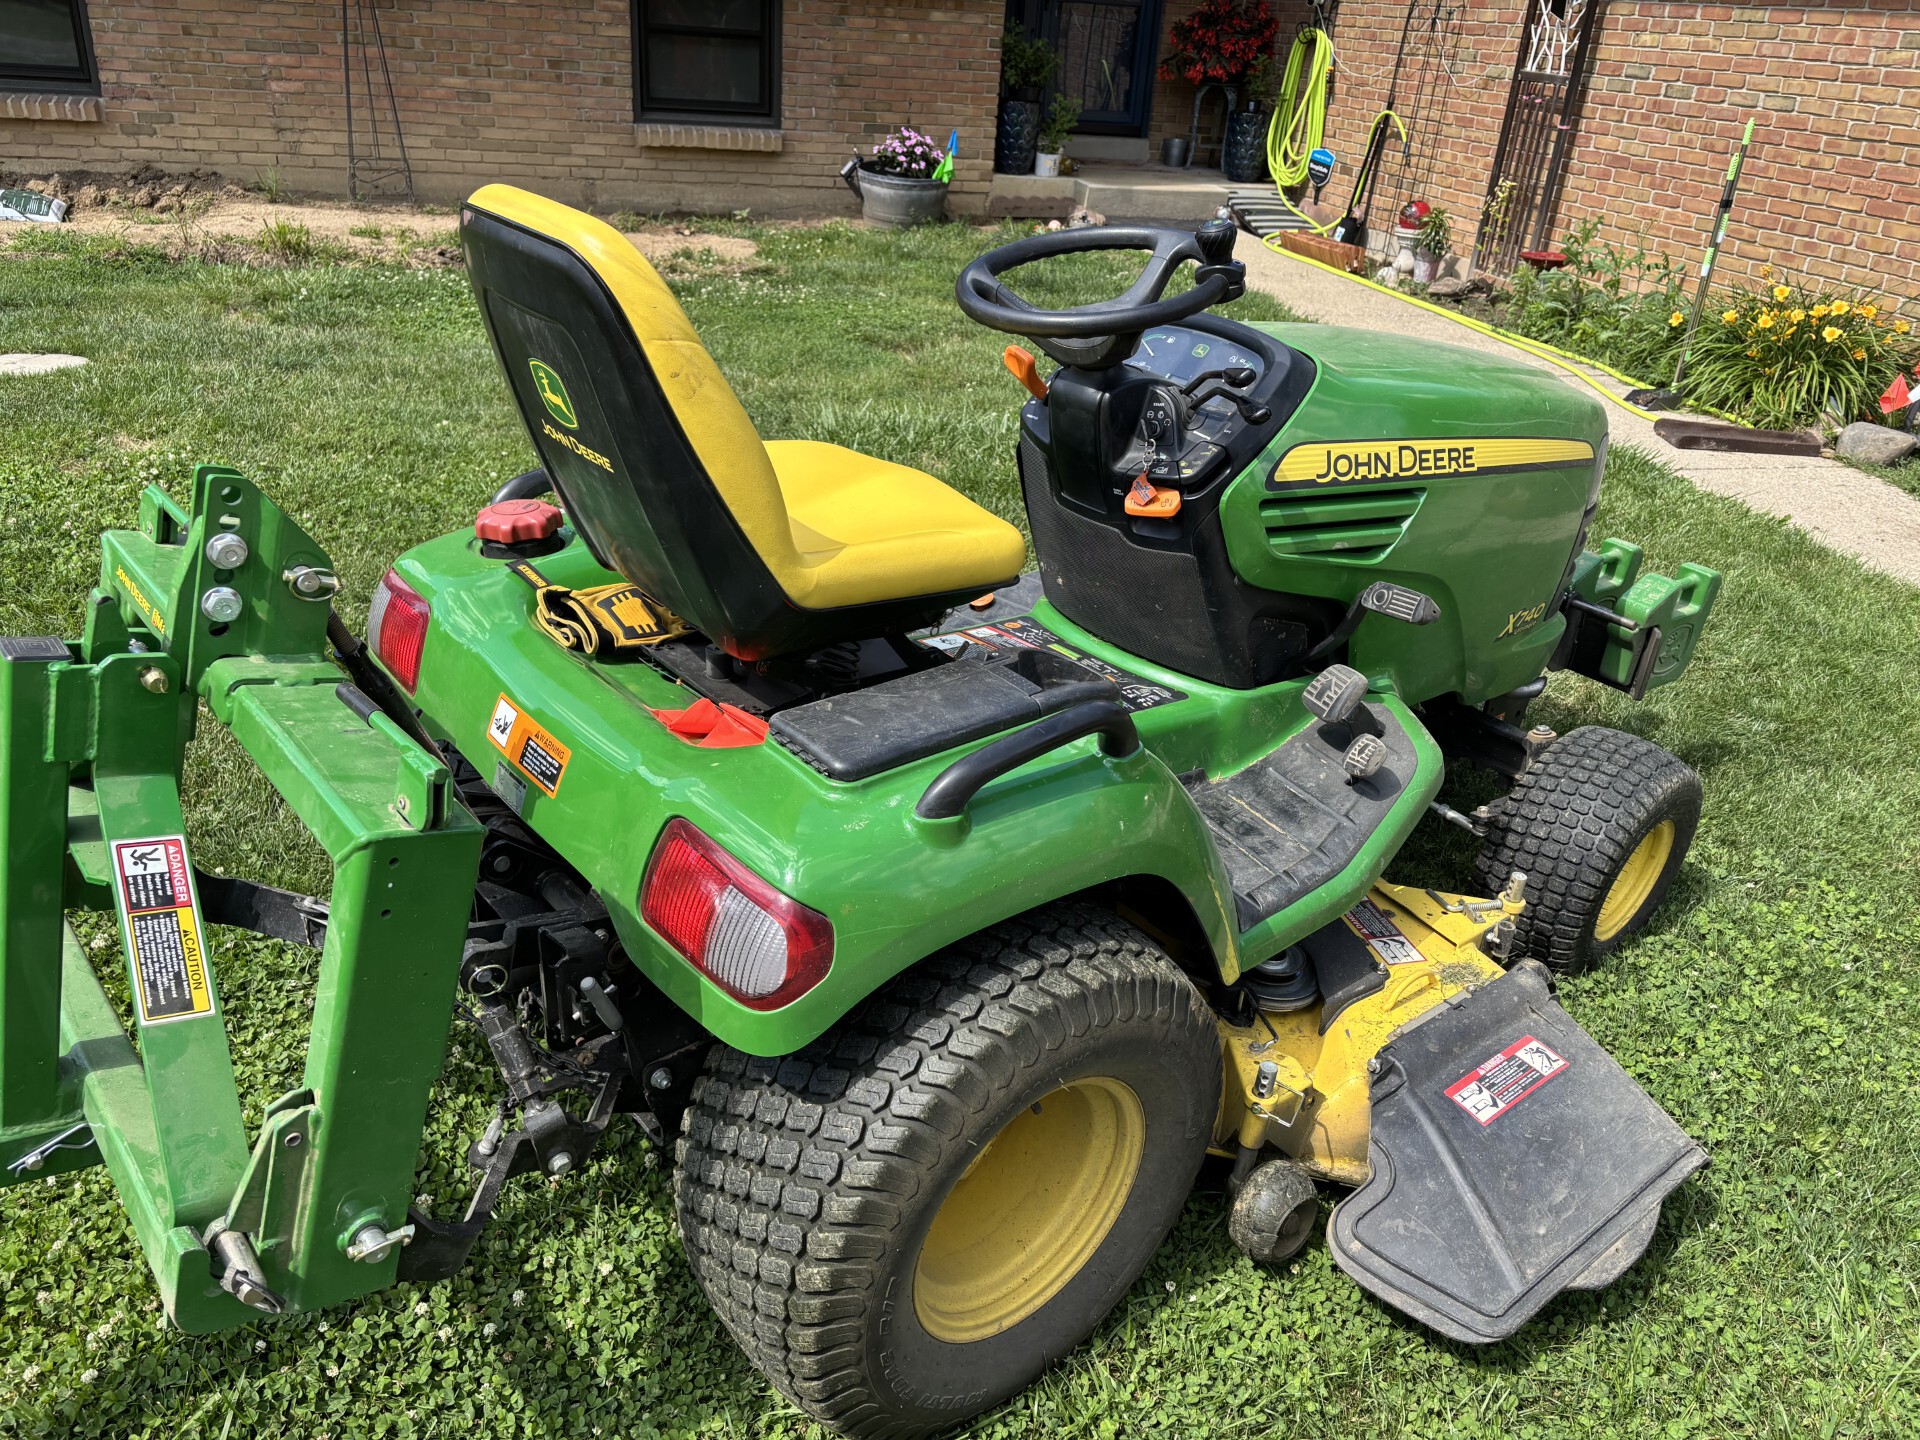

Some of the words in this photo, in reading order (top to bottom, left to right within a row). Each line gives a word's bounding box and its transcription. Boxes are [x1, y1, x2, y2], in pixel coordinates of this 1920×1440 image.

[541, 418, 572, 450] JOHN
[568, 435, 615, 474] DEERE
[1316, 449, 1391, 481] JOHN
[1398, 445, 1476, 473] DEERE
[517, 564, 548, 588] DEWALT
[116, 564, 132, 590] JOHN
[130, 582, 151, 616] DEERE
[1497, 602, 1546, 638] X740
[539, 734, 566, 760] WARNING
[135, 875, 143, 889] carry
[145, 874, 153, 890] death
[153, 873, 162, 889] injury
[169, 853, 188, 902] DANGER
[129, 884, 137, 903] carrier
[164, 880, 172, 895] avoid
[133, 921, 142, 936] Keep
[146, 919, 155, 940] Always
[152, 918, 160, 931] load
[164, 917, 172, 932] using
[171, 916, 179, 931] Read
[167, 933, 175, 947] hitch
[138, 949, 146, 963] clear
[143, 943, 151, 957] level
[149, 940, 158, 961] remove
[158, 918, 168, 941] Stability
[164, 948, 173, 971] affected
[169, 979, 177, 998] towed
[140, 964, 149, 980] when
[178, 959, 187, 980] manual
[183, 937, 203, 990] CAUTION
[155, 972, 166, 1005] attachment
[182, 980, 191, 999] before
[1482, 1053, 1506, 1072] DANGER
[915, 1387, 988, 1410] MULTI
